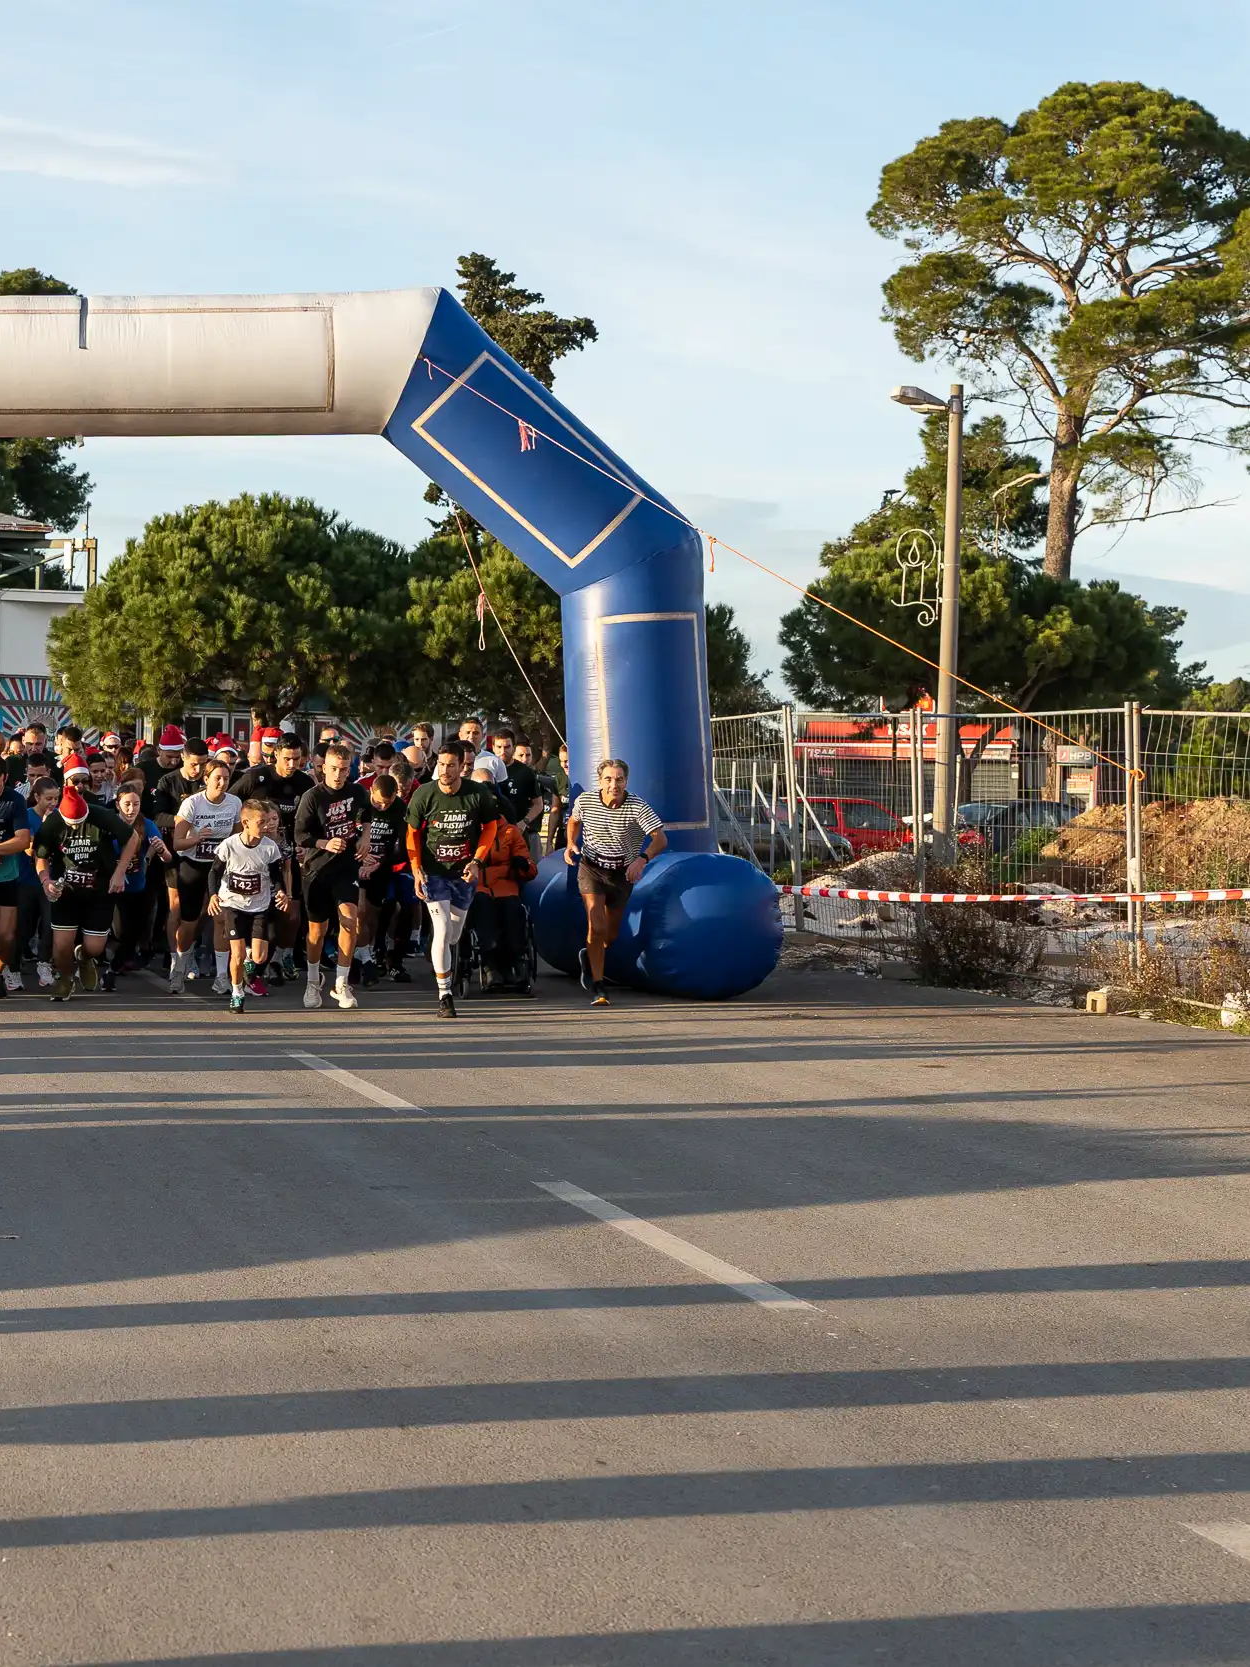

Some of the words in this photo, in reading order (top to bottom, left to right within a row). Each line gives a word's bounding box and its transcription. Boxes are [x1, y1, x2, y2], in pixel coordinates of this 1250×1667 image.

[887, 723, 929, 736] TSAK
[1069, 752, 1091, 761] HPB
[443, 813, 467, 822] ZADAR
[330, 825, 349, 838] 145
[70, 839, 90, 847] ZADAR
[74, 853, 89, 861] RUN
[439, 848, 460, 857] 346
[66, 873, 86, 884] 321
[233, 880, 252, 890] 142
